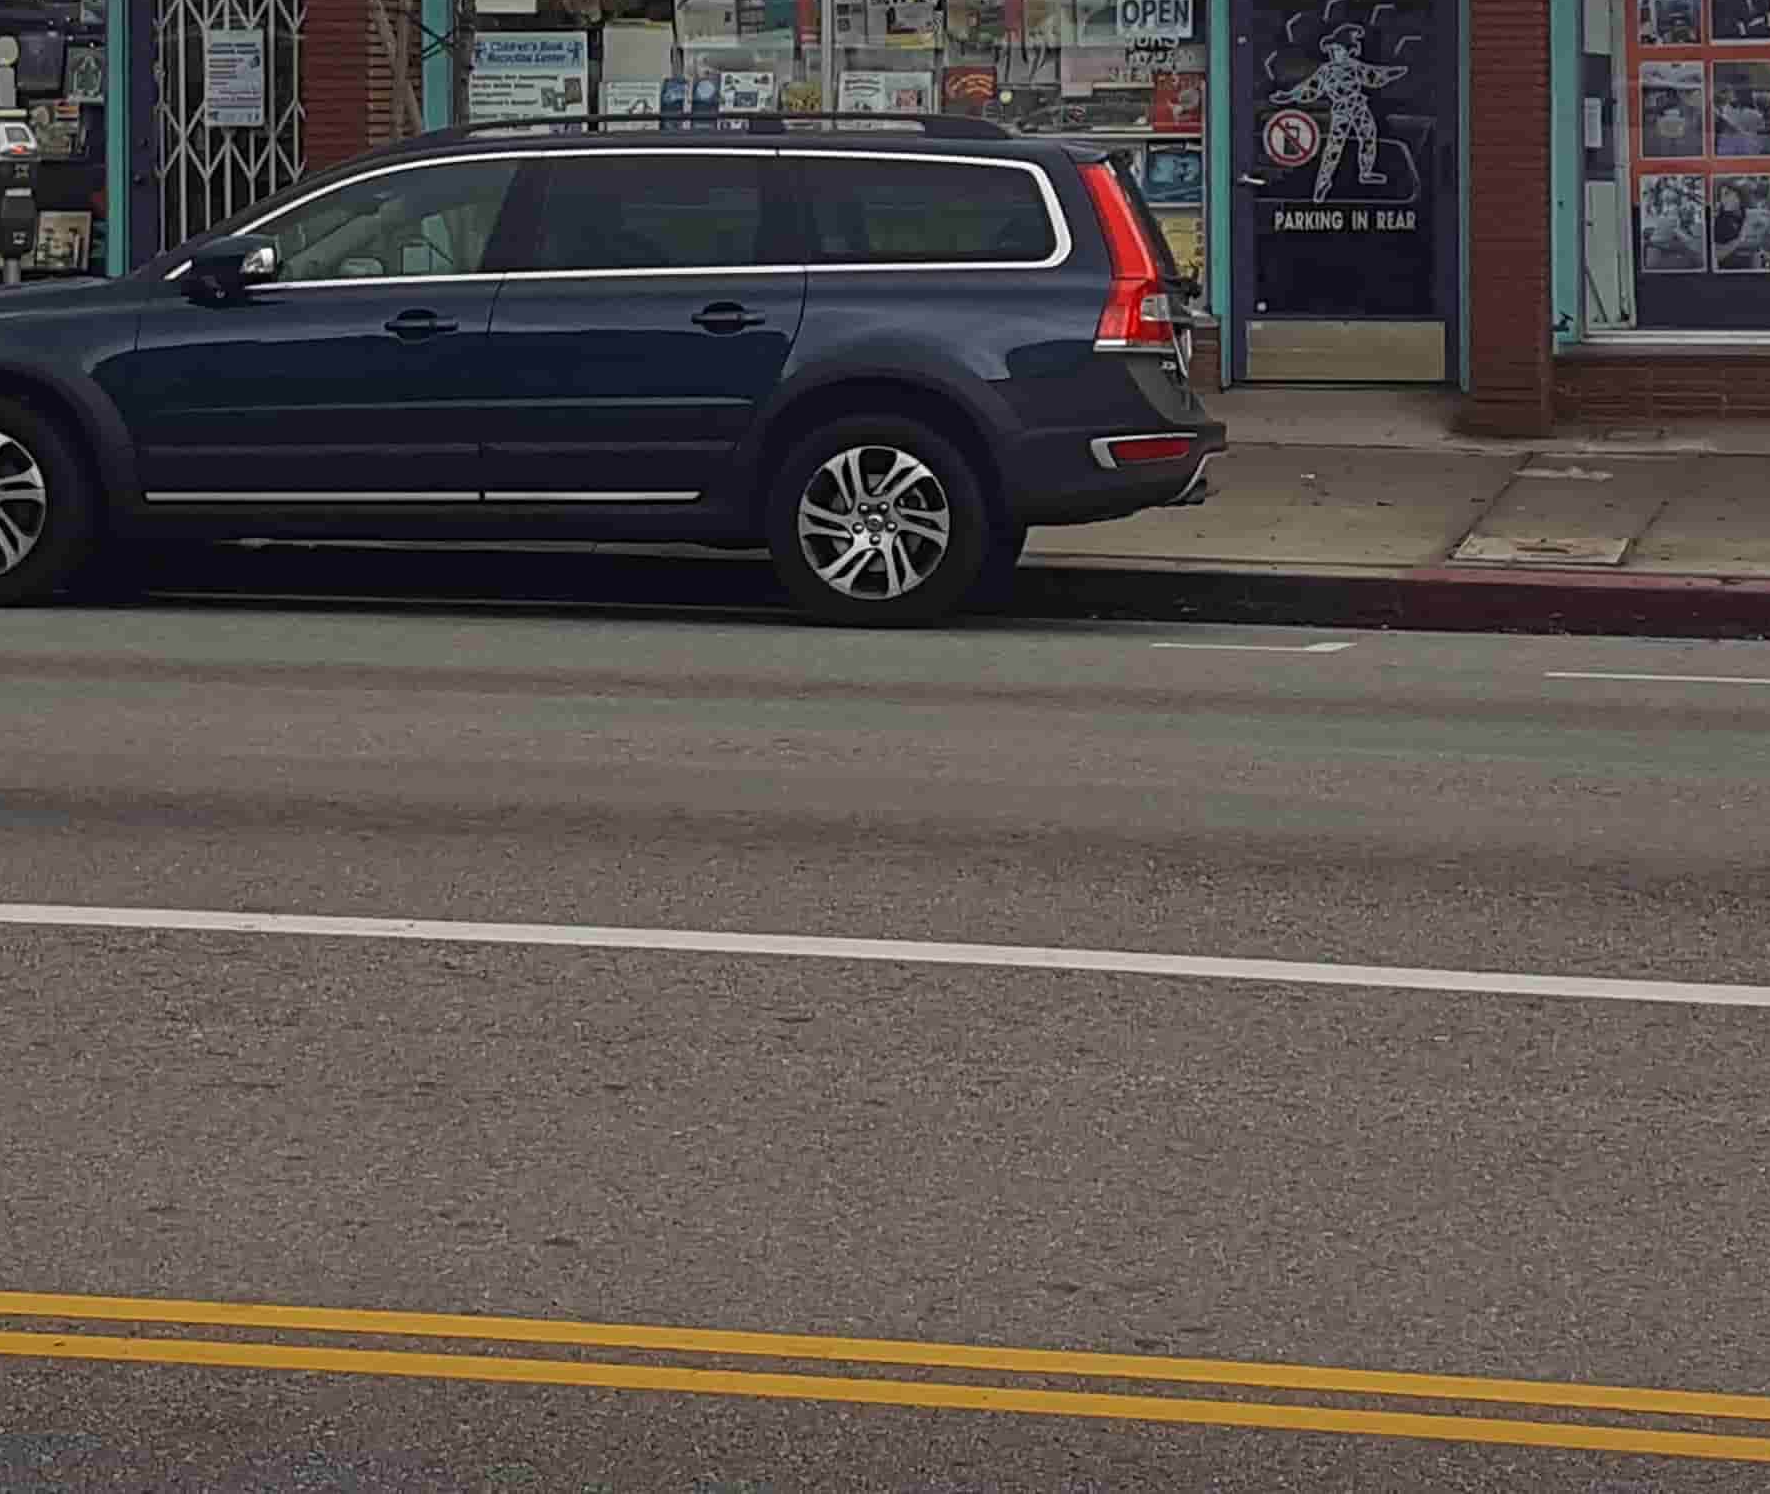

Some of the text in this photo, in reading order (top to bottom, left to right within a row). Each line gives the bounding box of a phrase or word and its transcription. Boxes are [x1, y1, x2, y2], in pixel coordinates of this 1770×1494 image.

[1123, 0, 1189, 26] OPEN
[1273, 209, 1416, 231] PARKING IN REAR
